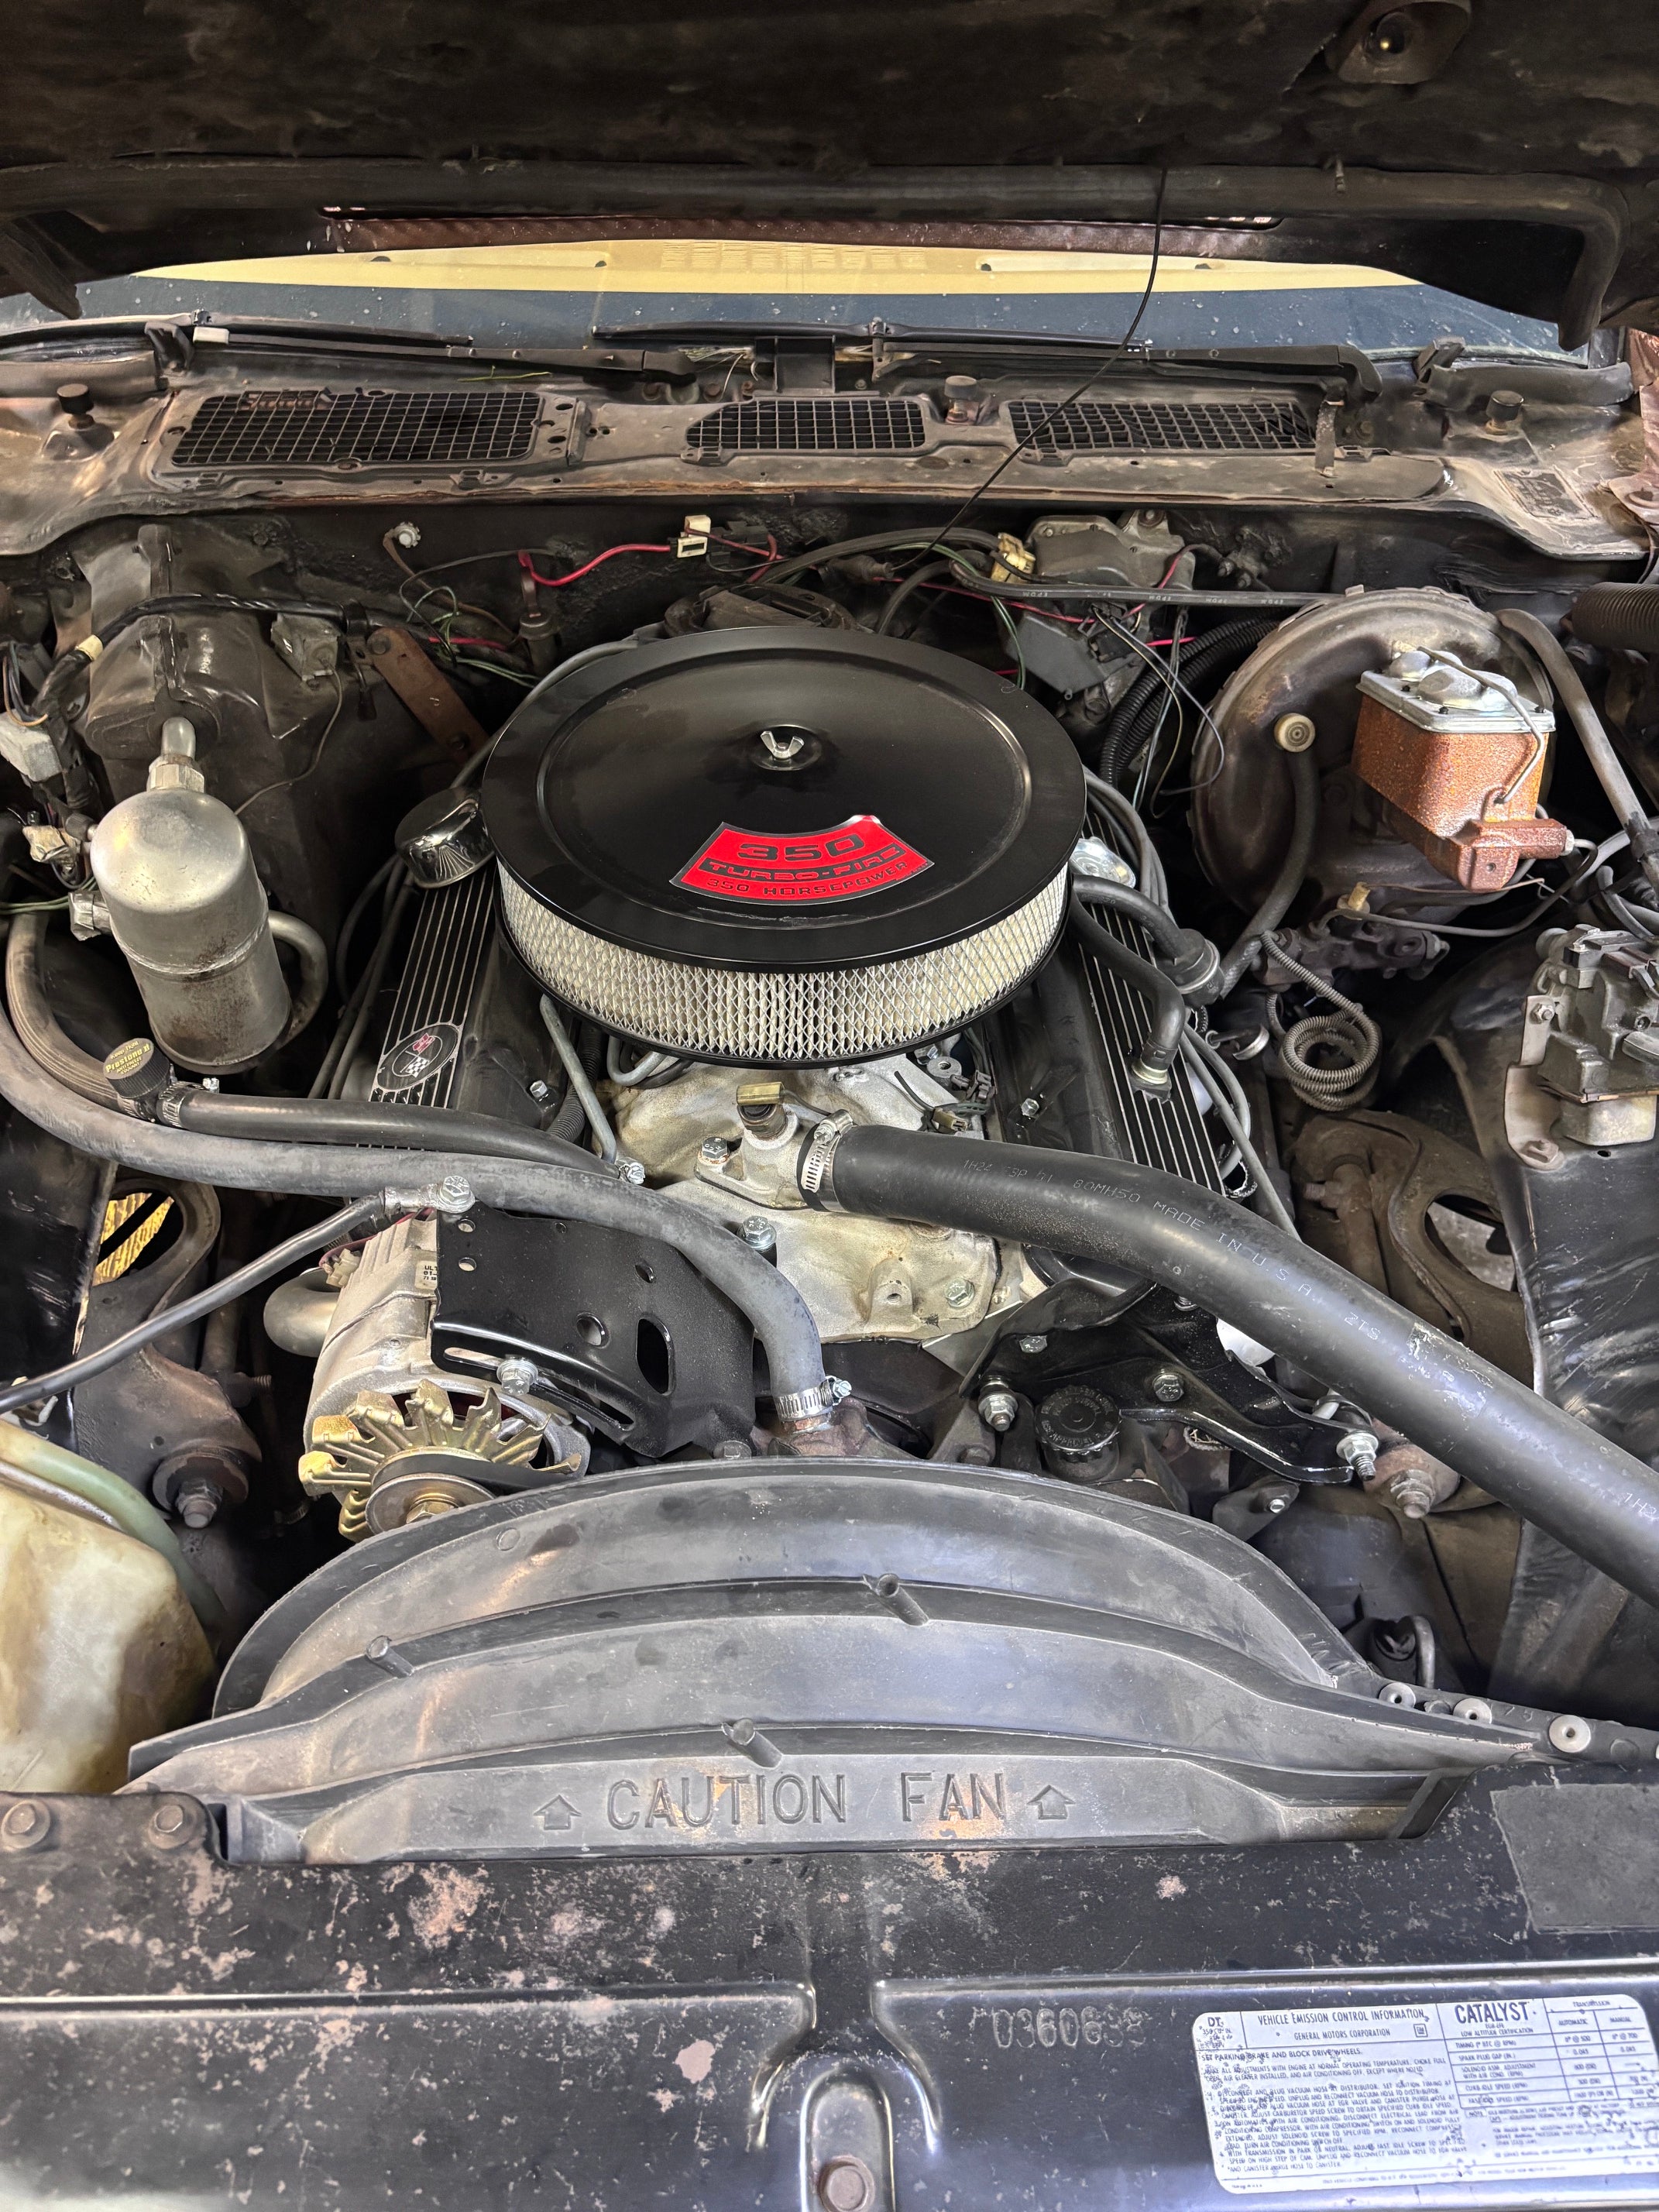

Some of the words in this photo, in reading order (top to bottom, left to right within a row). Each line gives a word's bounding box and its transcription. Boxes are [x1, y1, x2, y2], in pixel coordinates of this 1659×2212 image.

[737, 833, 865, 861] 350
[706, 878, 750, 893] 350
[764, 861, 907, 895] HORSEPOWER
[709, 847, 903, 880] TURBO-FIRE
[1152, 1200, 1205, 1231] MADE
[1216, 1232, 1242, 1252] IN
[607, 1773, 846, 1829] CAUTION
[901, 1771, 1007, 1822] FAN
[1258, 2014, 1289, 2026] VEHICLE
[1291, 2012, 1329, 2025] EMISSION
[1332, 2011, 1369, 2022] CONTROL
[1371, 2008, 1425, 2021] INFORMATION
[1455, 2001, 1529, 2024] CATALYST
[1294, 2032, 1320, 2041] GENERAL
[1323, 2030, 1348, 2039] MOTORS
[1349, 2028, 1391, 2038] CORPORATION
